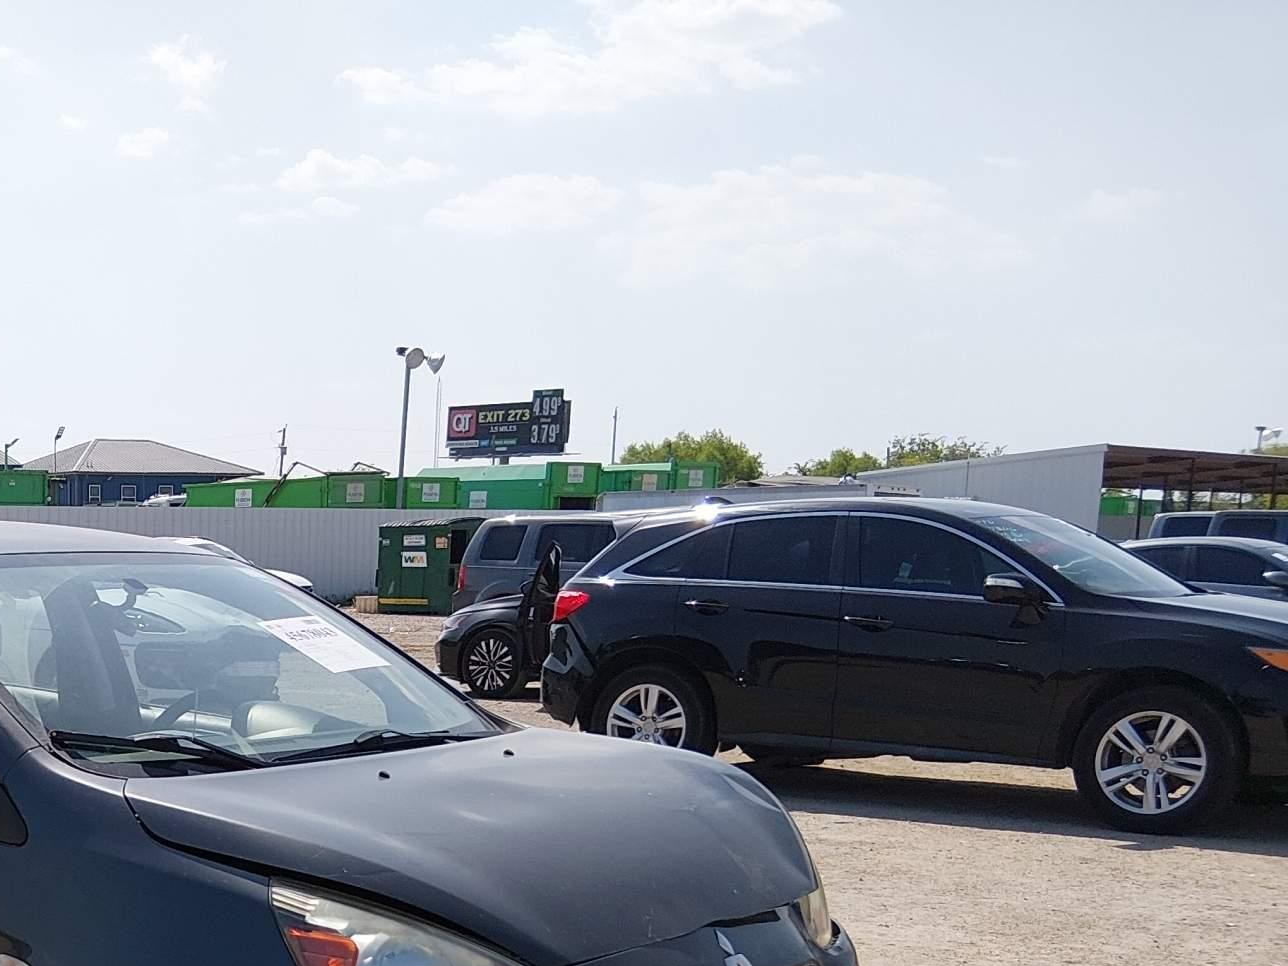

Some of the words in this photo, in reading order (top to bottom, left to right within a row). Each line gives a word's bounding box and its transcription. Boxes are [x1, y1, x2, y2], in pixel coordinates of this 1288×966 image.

[478, 411, 505, 423] EXIT
[507, 409, 530, 421] 273
[452, 414, 472, 433] QT
[404, 555, 425, 564] WM
